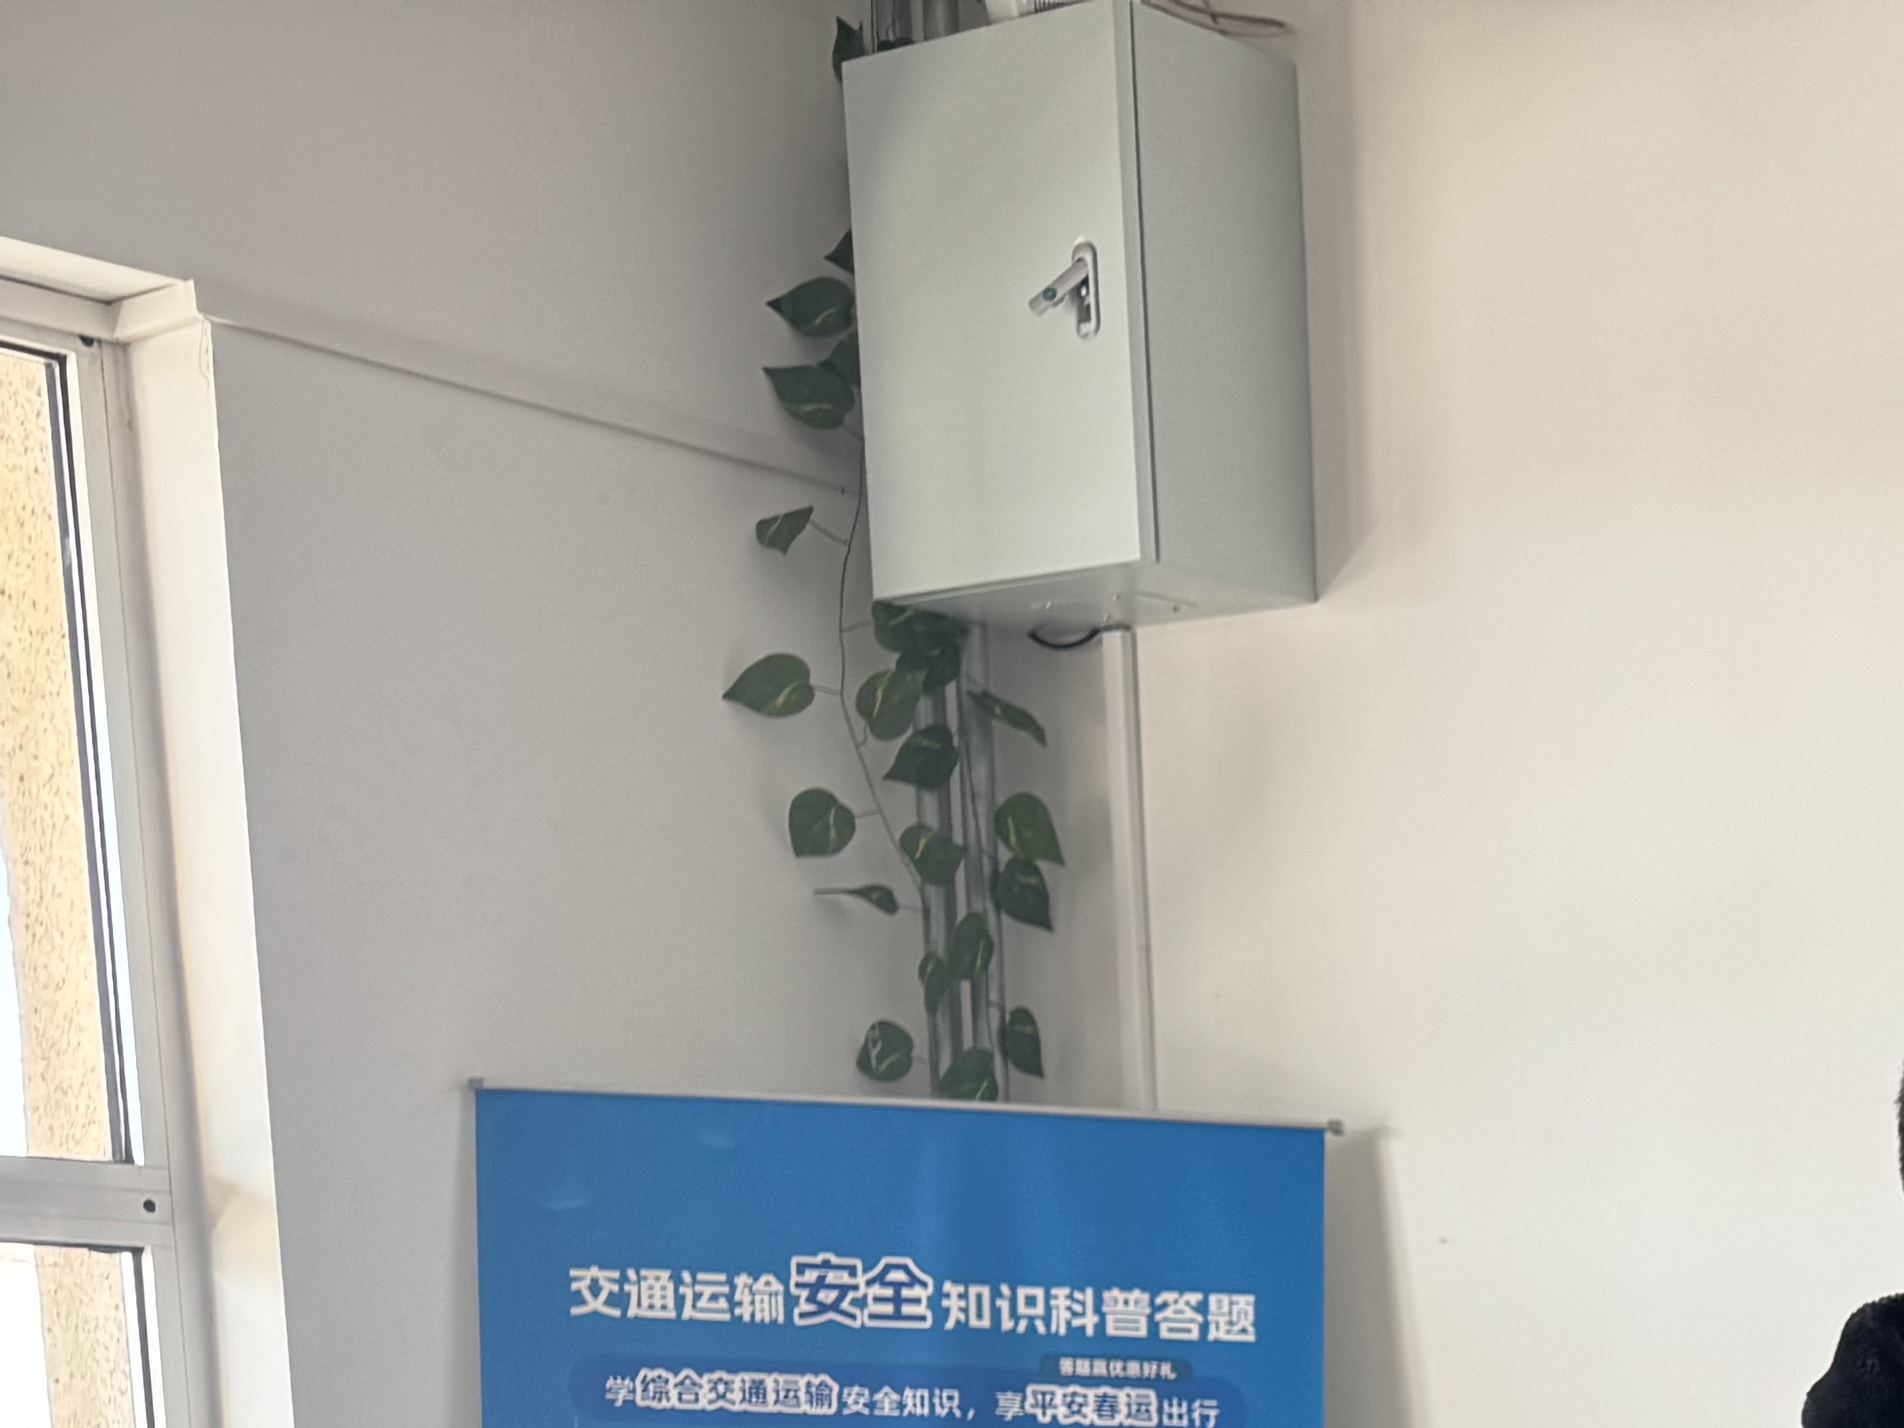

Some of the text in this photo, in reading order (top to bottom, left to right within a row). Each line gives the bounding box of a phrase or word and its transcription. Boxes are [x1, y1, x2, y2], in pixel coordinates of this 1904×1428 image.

[569, 1252, 1257, 1343] 交通运输安全知识科普答题
